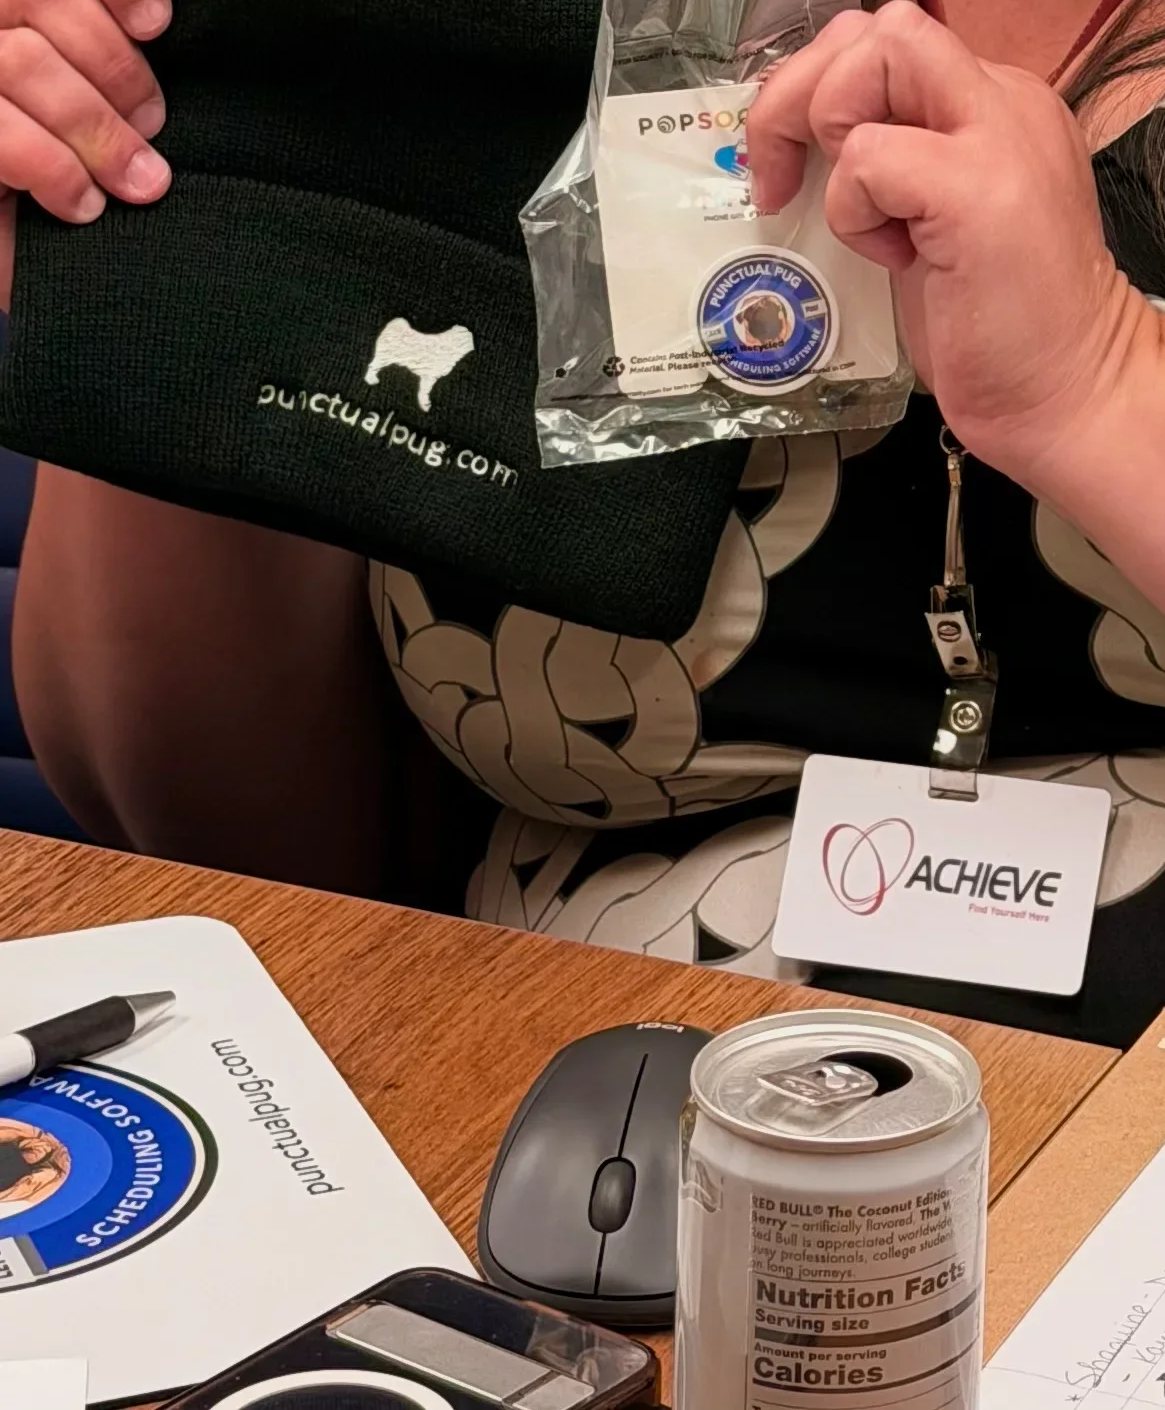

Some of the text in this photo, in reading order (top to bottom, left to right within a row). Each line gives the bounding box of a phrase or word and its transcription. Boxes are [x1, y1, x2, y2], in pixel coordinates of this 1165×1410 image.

[639, 106, 750, 135] POPSO
[709, 263, 802, 308] PUNCTUAL PUG
[668, 361, 699, 371] Please
[904, 855, 1062, 908] ACHIEVE
[968, 903, 1050, 922] Find Yourself Here
[210, 1038, 345, 1197] punctualpug.com
[29, 1076, 163, 1247] SCHEDULING SOFTWA
[751, 1195, 776, 1211] RED
[827, 1206, 853, 1219] The
[857, 1201, 913, 1218] Coconut
[751, 1211, 787, 1230] Berry
[802, 1219, 862, 1235] artificially
[920, 1205, 940, 1222] The
[775, 1231, 797, 1246] Bull
[802, 1234, 812, 1249] is
[817, 1234, 894, 1252] appreciated
[781, 1249, 868, 1264] professionals,
[872, 1244, 916, 1261] college
[766, 1259, 794, 1277] long
[756, 1260, 967, 1310] Nutrition Facts
[755, 1307, 870, 1333] Serving size
[754, 1341, 887, 1363] Amount per serving
[753, 1356, 885, 1386] Calories
